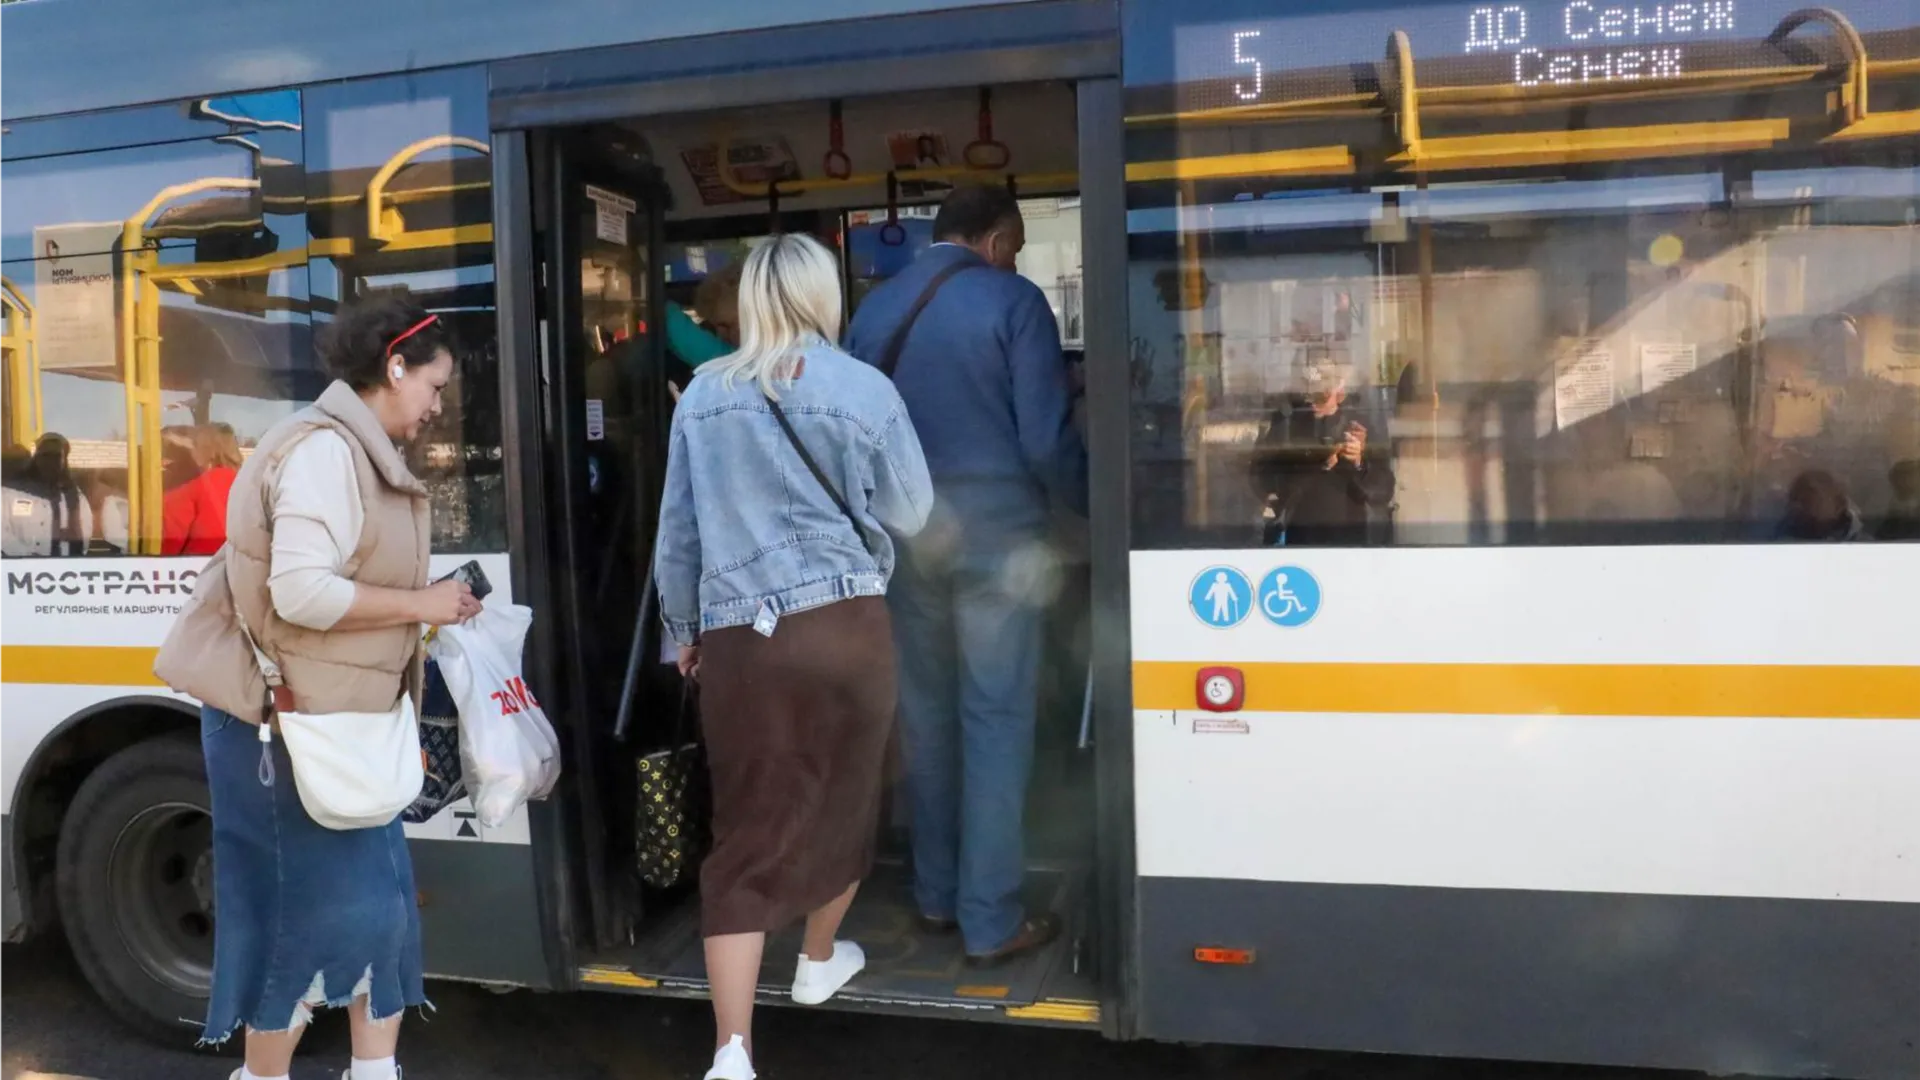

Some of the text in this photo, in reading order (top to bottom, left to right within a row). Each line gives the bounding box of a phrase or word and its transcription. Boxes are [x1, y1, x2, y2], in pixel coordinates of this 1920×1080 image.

[1564, 0, 1734, 40] Сенеж
[1234, 31, 1261, 99] 5
[1514, 47, 1682, 86] Сенеж
[35, 604, 182, 614] РЕГУЛЯРНЫЕ МАРШРУТЫ
